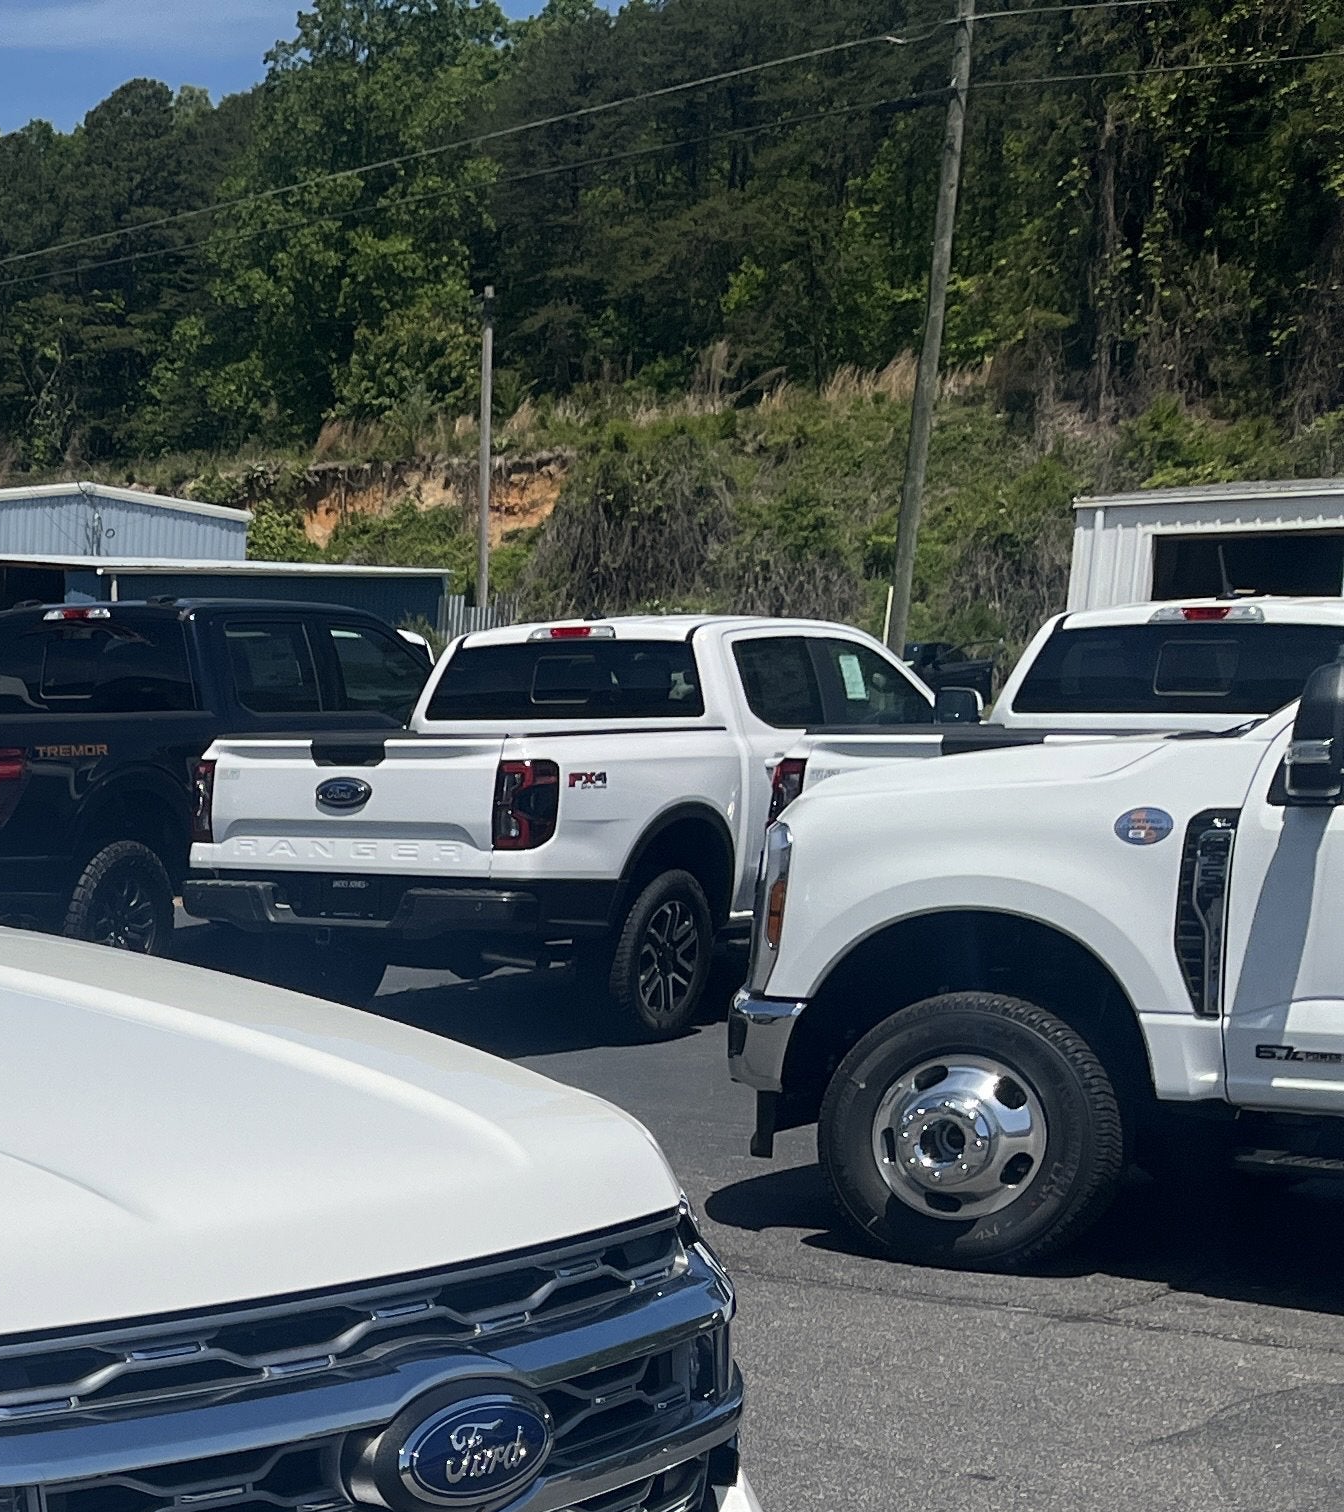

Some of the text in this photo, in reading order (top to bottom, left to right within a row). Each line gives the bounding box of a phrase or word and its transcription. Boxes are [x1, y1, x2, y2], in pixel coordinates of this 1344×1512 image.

[35, 744, 109, 758] TREMOR
[568, 772, 607, 787] FX4
[233, 838, 462, 863] RANGER
[1256, 1045, 1304, 1061] 6.7L
[445, 1418, 528, 1484] Ford
